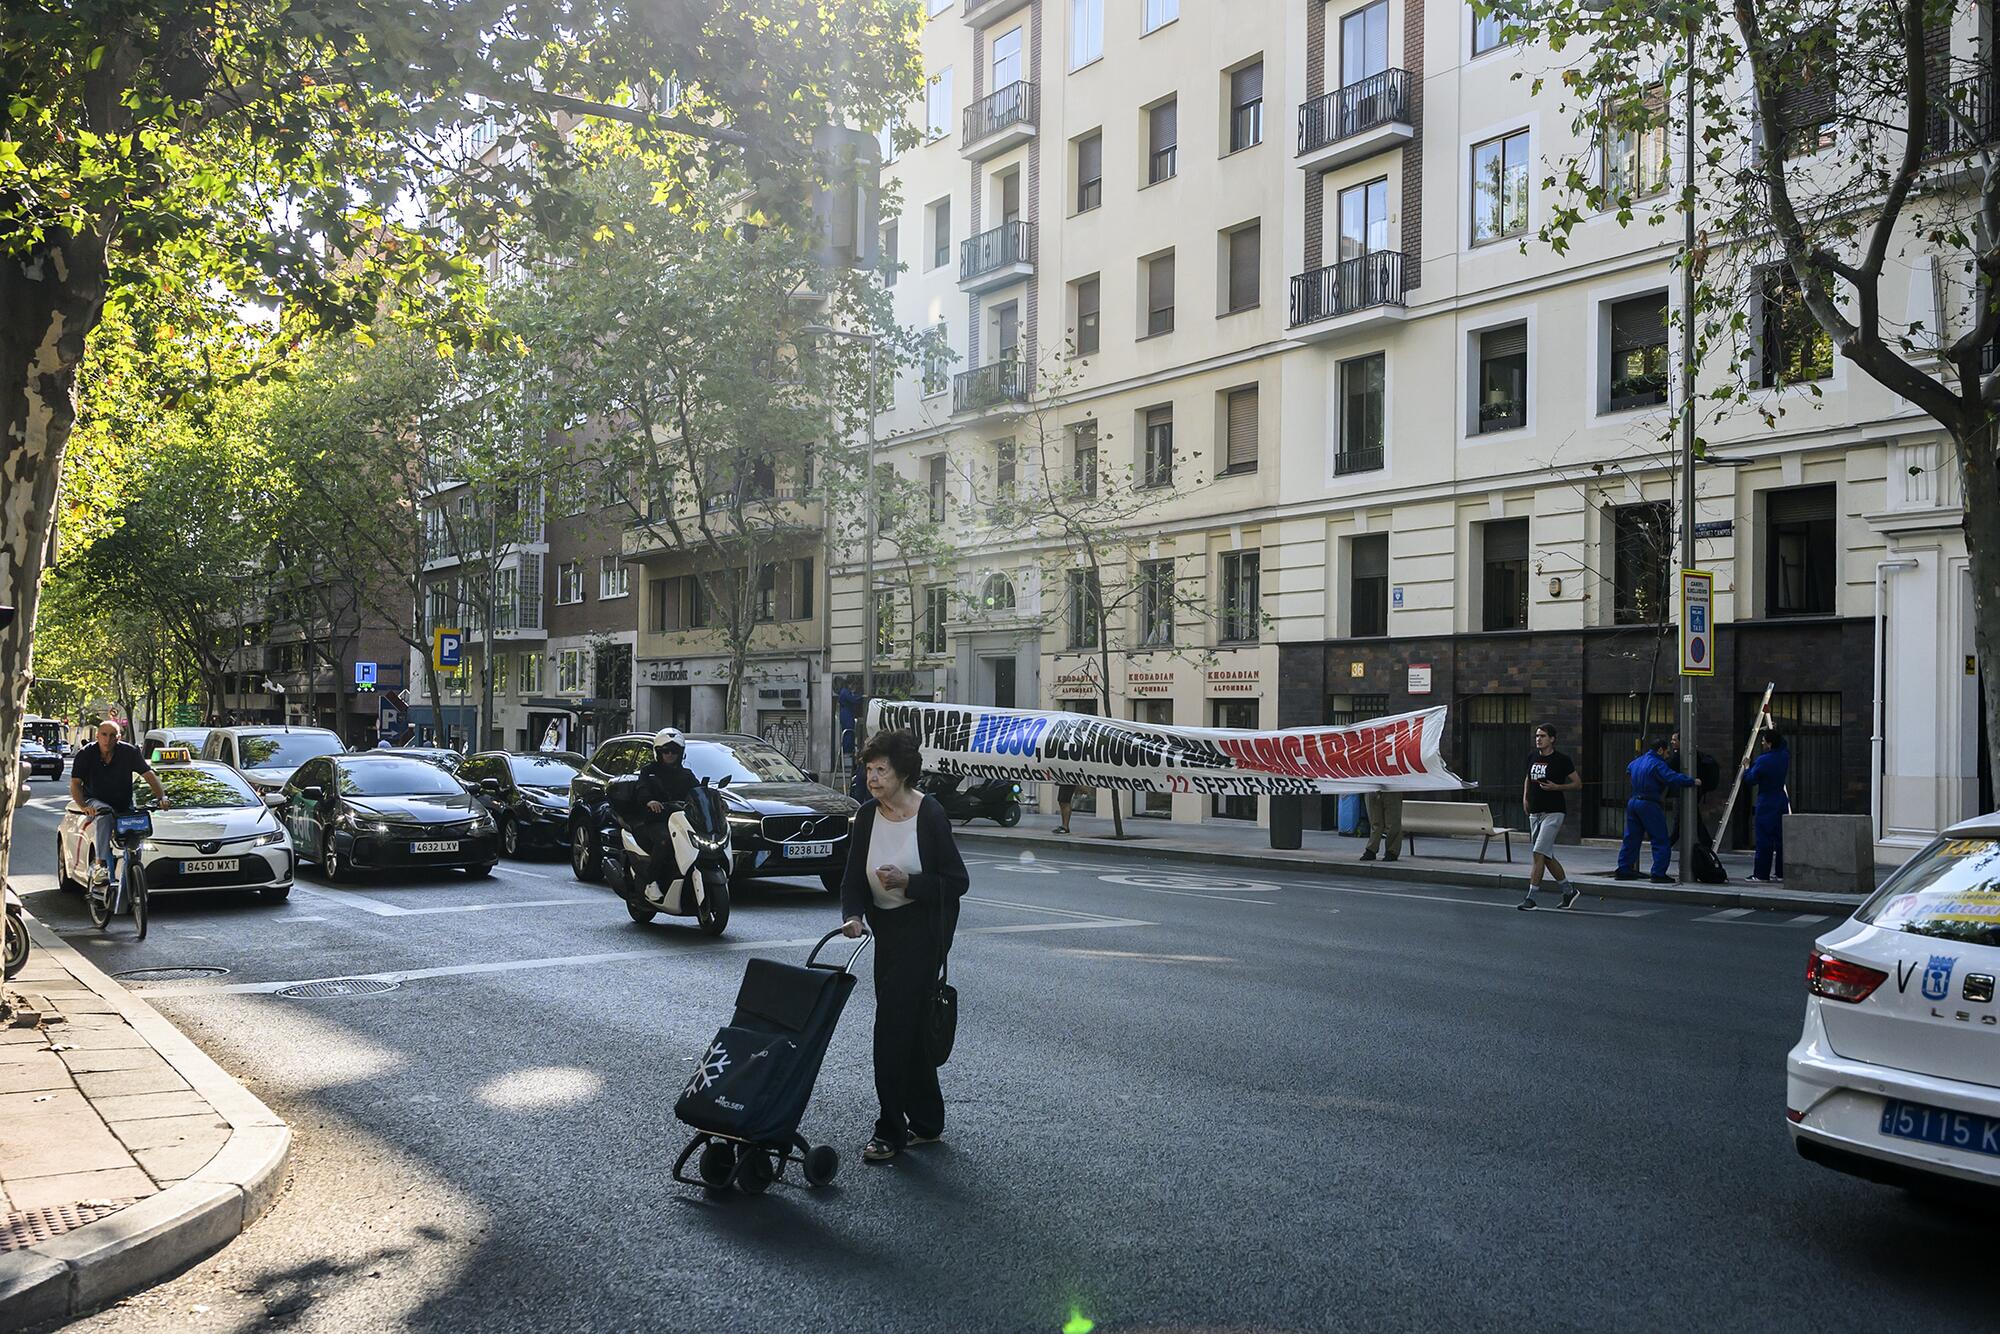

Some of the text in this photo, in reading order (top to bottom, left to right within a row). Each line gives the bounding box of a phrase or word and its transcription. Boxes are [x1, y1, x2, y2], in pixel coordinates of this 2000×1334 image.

[443, 638, 458, 657] P
[361, 665, 371, 680] P
[1207, 670, 1260, 680] KHODADIAN
[1352, 663, 1363, 676] 36
[1128, 673, 1174, 681] KHODADIAN
[923, 708, 971, 752] PARA
[970, 713, 1047, 763] AYUSO,
[1044, 718, 1165, 767] DESAHUCIO
[1219, 716, 1428, 778] MARICARMEN
[161, 751, 178, 760] TAXI
[1530, 764, 1547, 774] FCK
[937, 757, 1321, 796] #AcampadaxMaricarmen 22 SEPTIEMBRE
[416, 842, 457, 851] 4632 LXV
[789, 844, 830, 855] 8238 LZL
[187, 860, 237, 871] 8450 MXT
[1898, 1104, 1970, 1145] 5115
